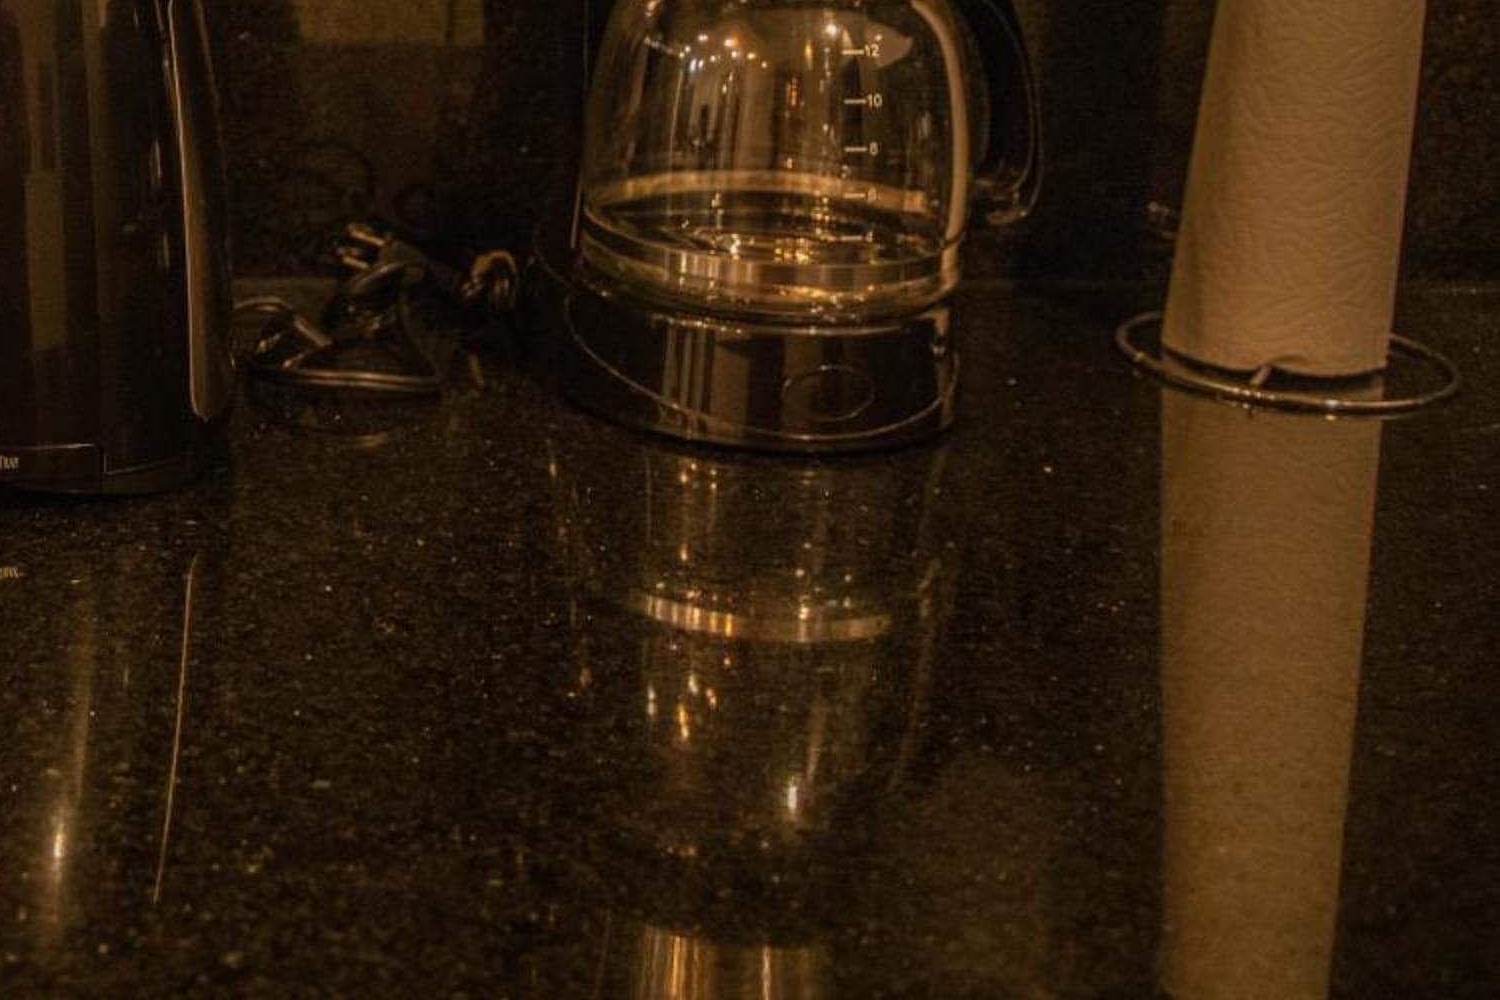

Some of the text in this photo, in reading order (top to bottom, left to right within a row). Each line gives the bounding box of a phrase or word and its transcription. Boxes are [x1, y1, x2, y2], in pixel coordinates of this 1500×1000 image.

[864, 44, 880, 57] 12
[867, 93, 883, 108] 10
[869, 141, 879, 157] 8
